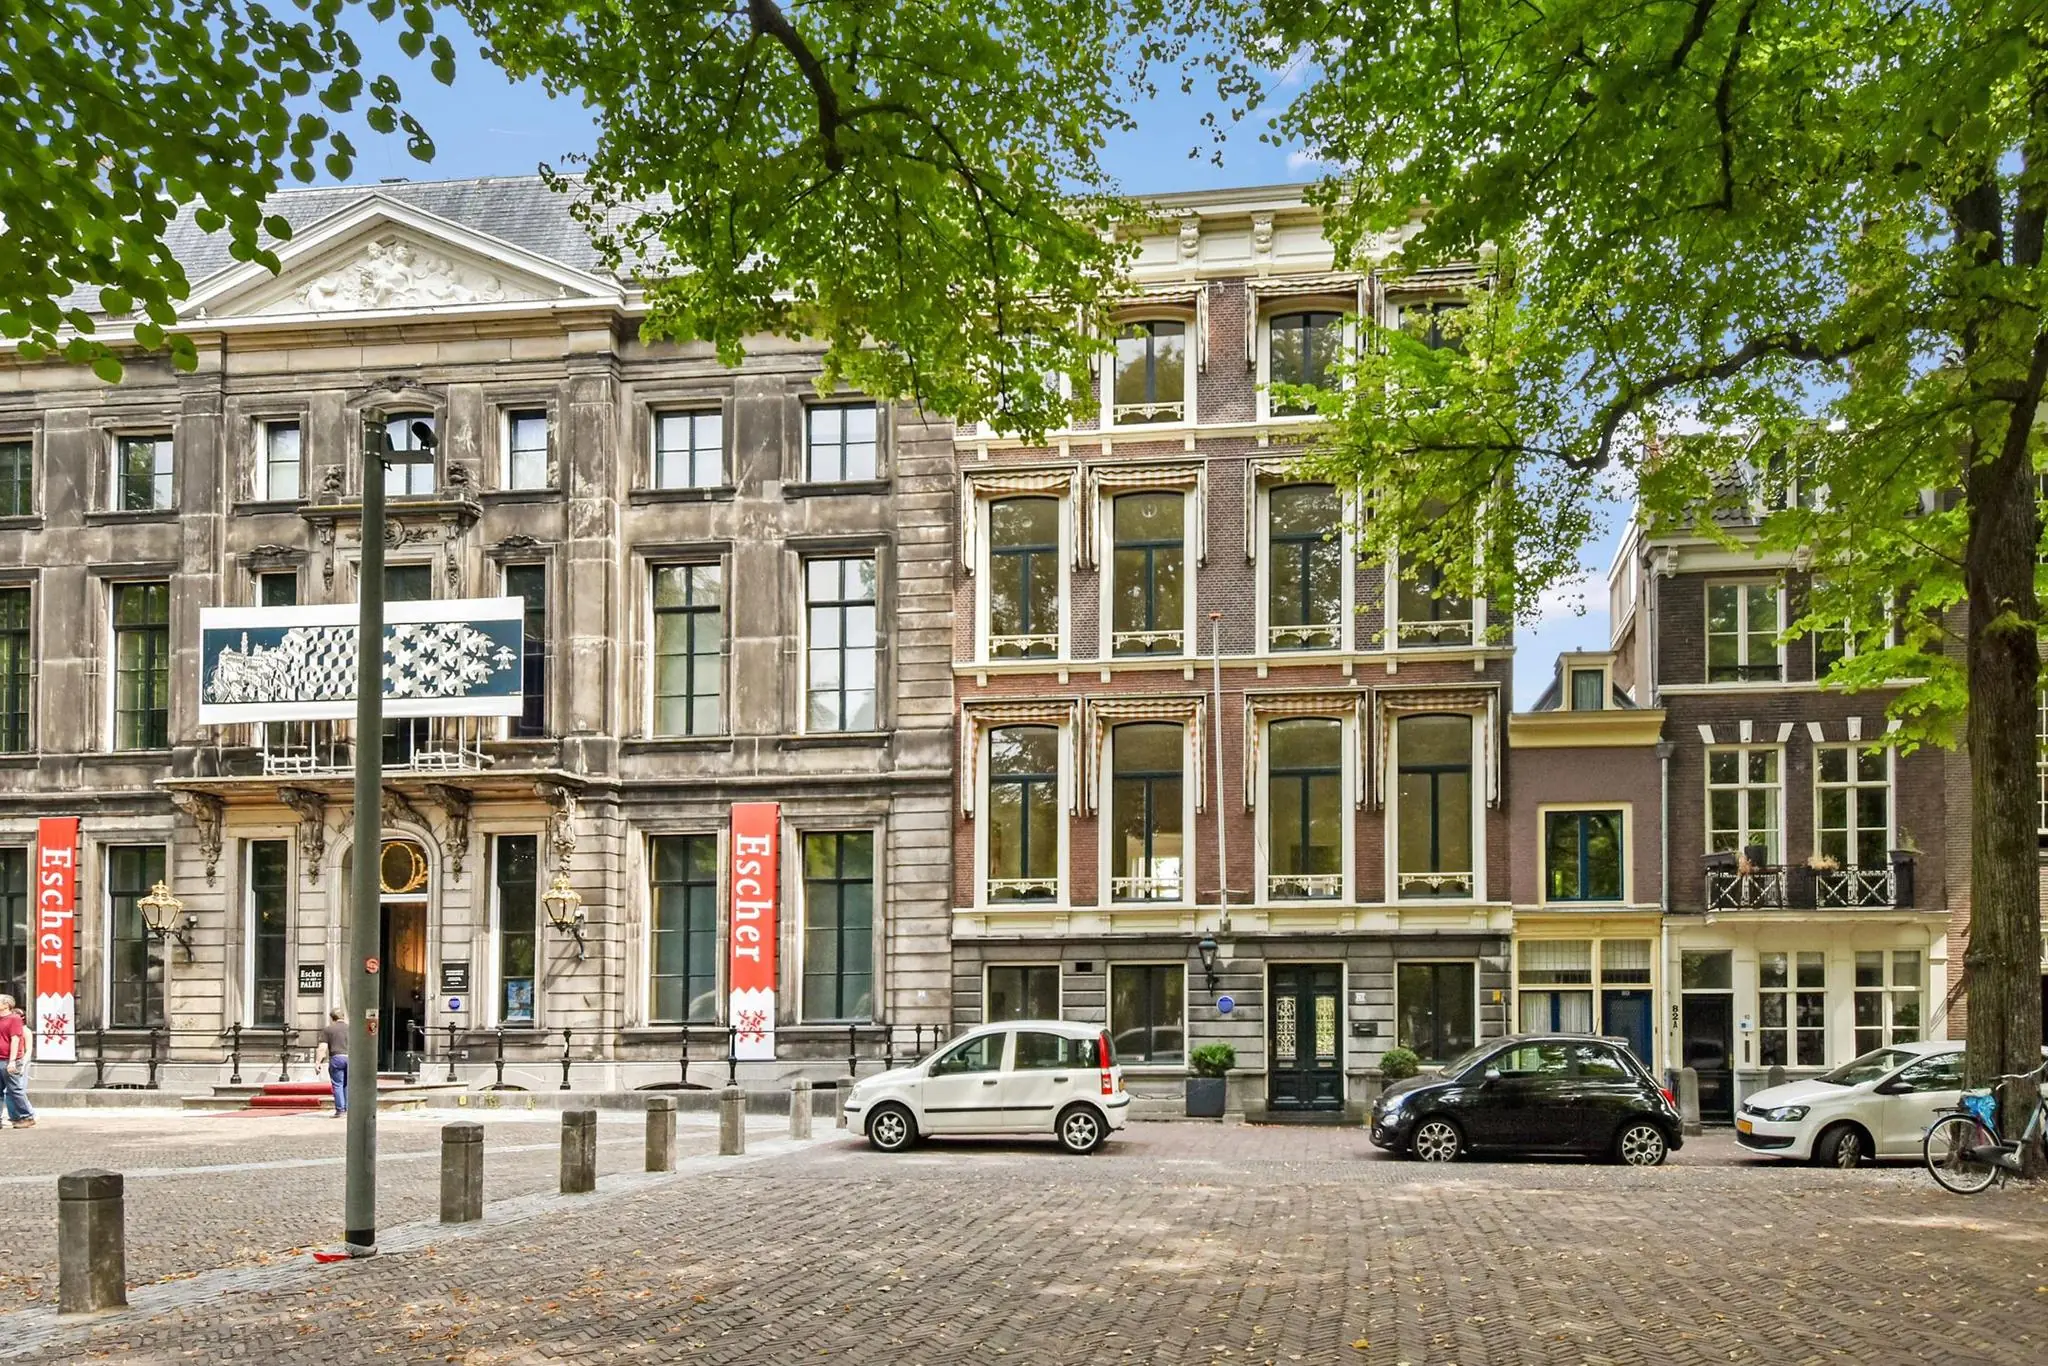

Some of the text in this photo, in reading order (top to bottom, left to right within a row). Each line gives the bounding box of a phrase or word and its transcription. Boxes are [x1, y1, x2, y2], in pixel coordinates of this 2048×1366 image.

[40, 846, 74, 969] Escher
[735, 833, 773, 963] Escher
[300, 969, 322, 978] Escher
